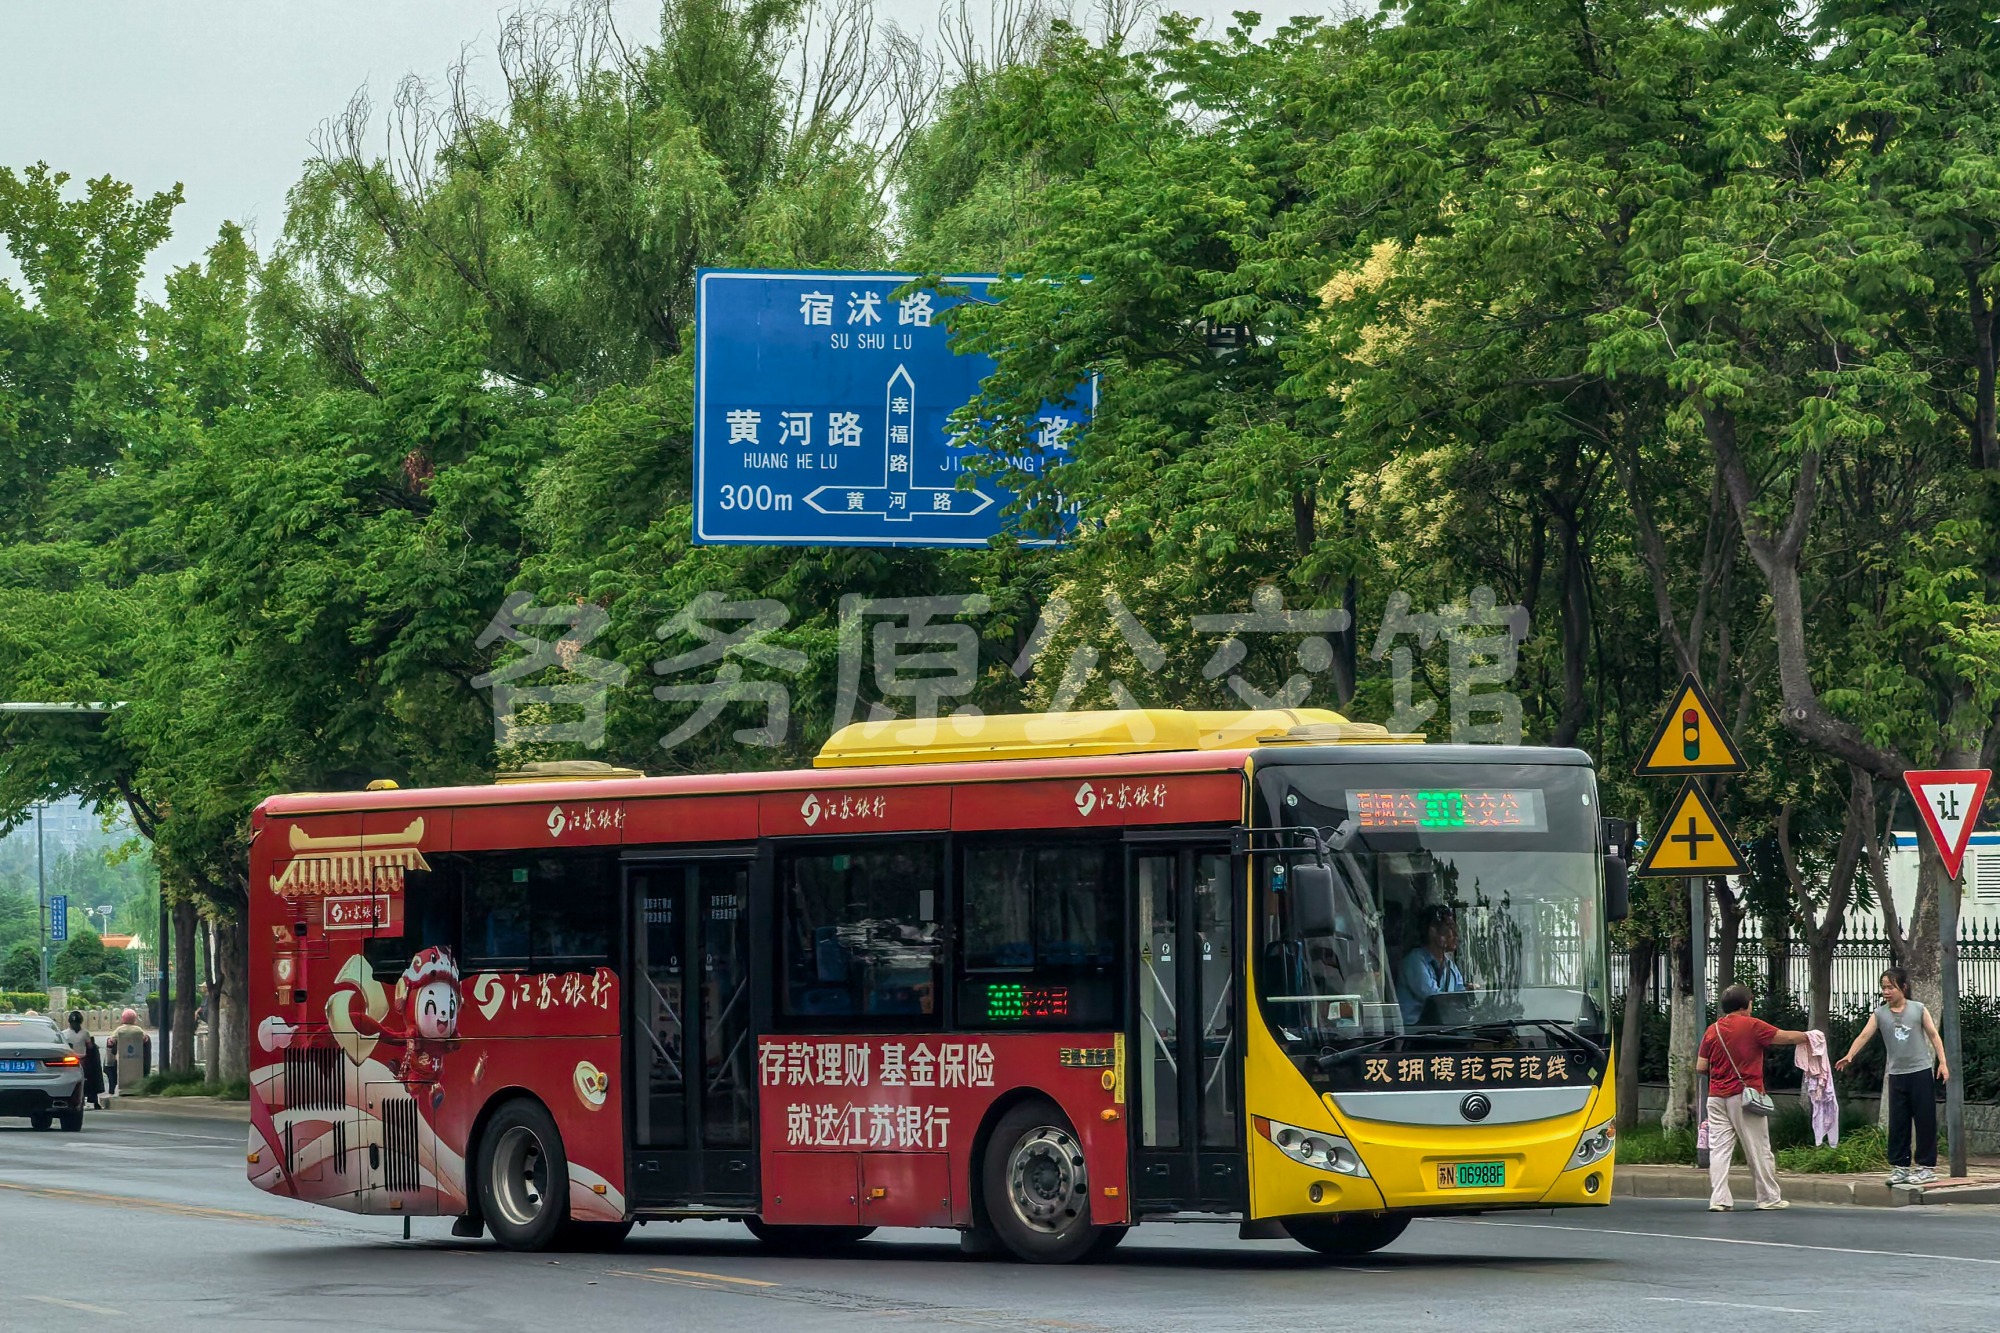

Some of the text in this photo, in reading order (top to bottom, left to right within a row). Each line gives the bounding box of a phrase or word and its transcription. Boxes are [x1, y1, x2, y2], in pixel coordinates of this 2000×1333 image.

[799, 290, 934, 327] 宿沭路
[830, 333, 912, 350] SU SHU LU
[726, 409, 864, 447] 黄河路
[889, 397, 909, 474] 幸福路
[743, 452, 838, 469] HUANG HE LU
[719, 485, 793, 512] 300m
[846, 491, 953, 512] 黄河路
[1935, 790, 1959, 821] 让
[758, 1041, 996, 1088] 存款理财 基金保险
[1363, 1055, 1569, 1083] 双拥模范示范线
[786, 1102, 951, 1149] 就选江苏银行
